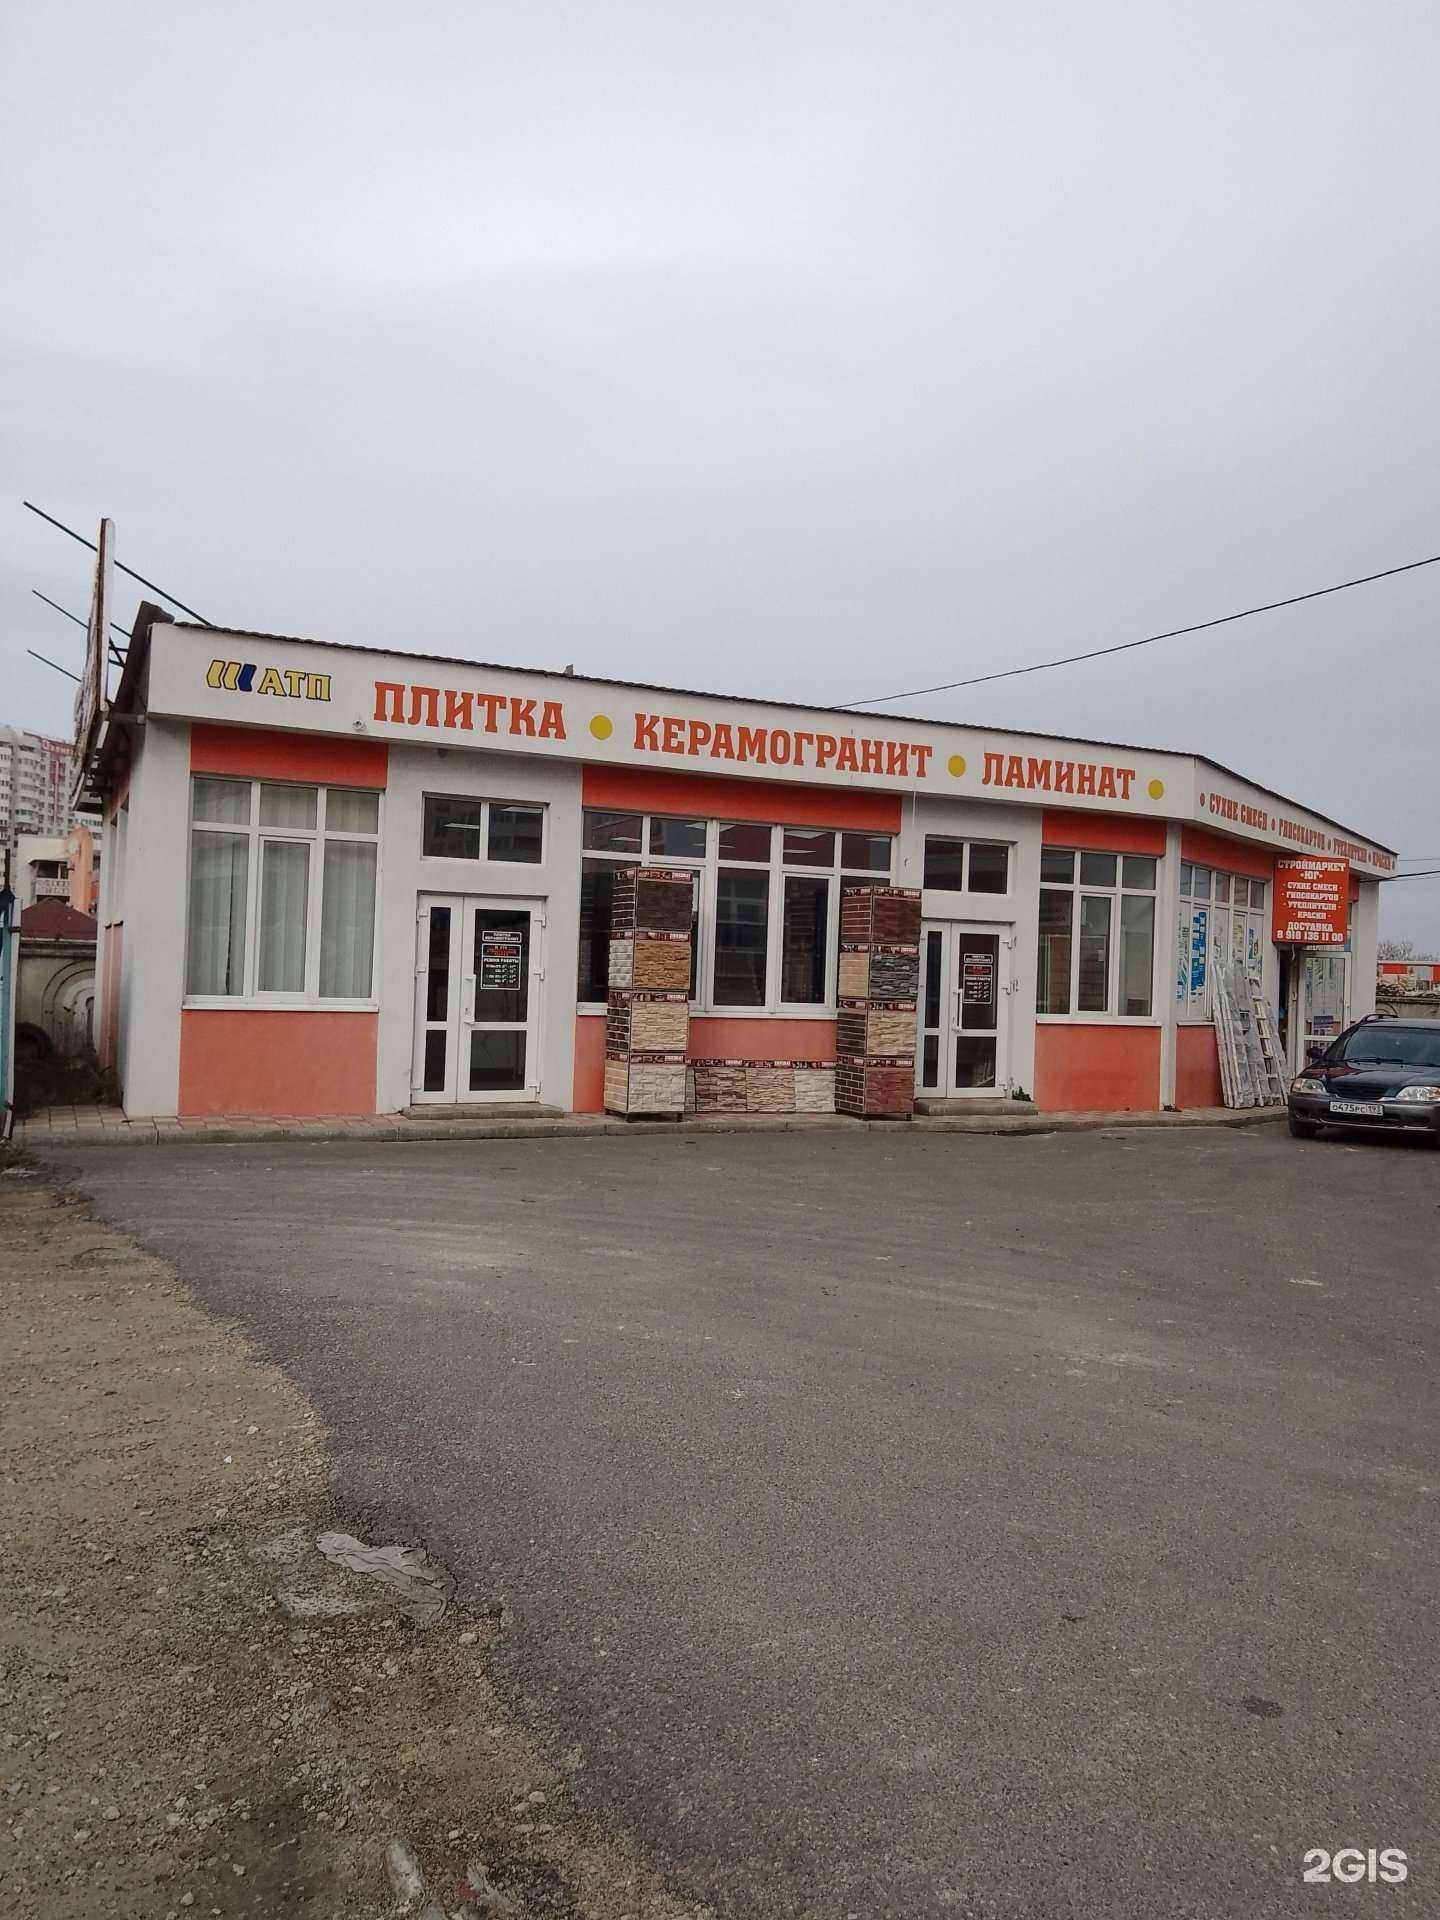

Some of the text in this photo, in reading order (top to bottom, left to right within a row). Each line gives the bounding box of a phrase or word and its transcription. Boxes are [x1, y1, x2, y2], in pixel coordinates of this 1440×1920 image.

[256, 667, 332, 702] АТП
[373, 680, 1136, 801] ПЛИТКА КЕРАМОГРАНИТ ЛАМИНАТ
[1209, 792, 1239, 821] СУХИЕ
[1240, 804, 1268, 831] СМЕСИ
[1277, 859, 1346, 872] СТРОЙМАРКЕТ
[1287, 921, 1334, 932] ДОСТАВКА
